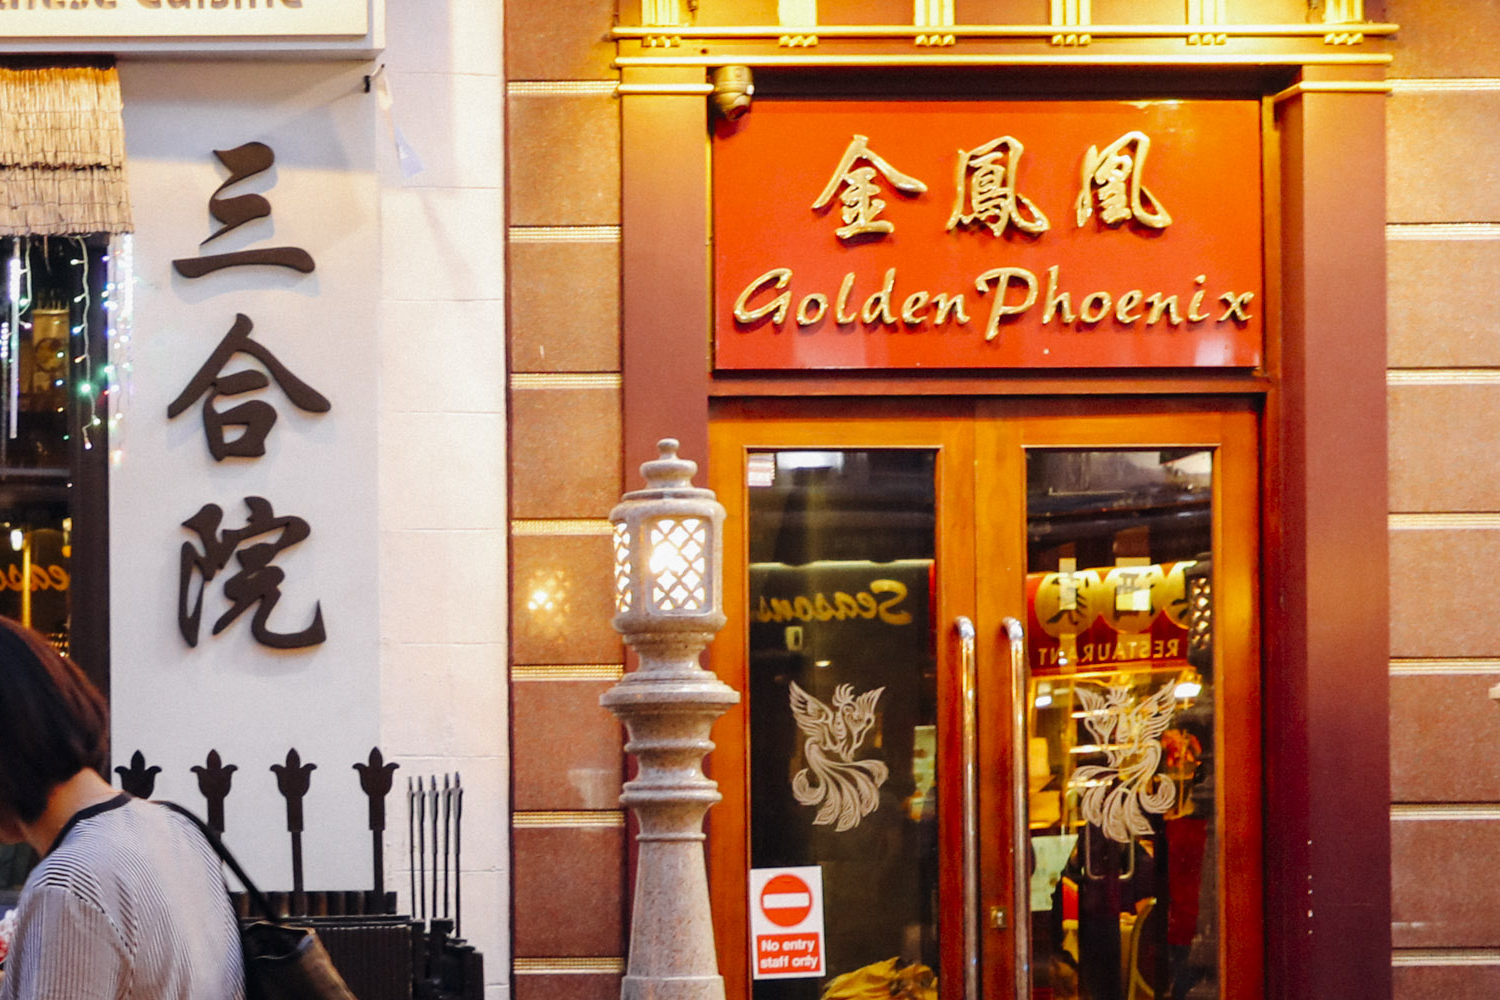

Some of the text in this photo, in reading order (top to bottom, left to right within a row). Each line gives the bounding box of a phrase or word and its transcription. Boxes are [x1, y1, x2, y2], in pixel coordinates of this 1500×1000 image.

[811, 131, 1173, 239] 金鳳凰
[733, 265, 1255, 341] Golden Phoenix
[167, 141, 332, 649] 三合院
[760, 955, 818, 970] staff only
[761, 938, 815, 953] No entry
